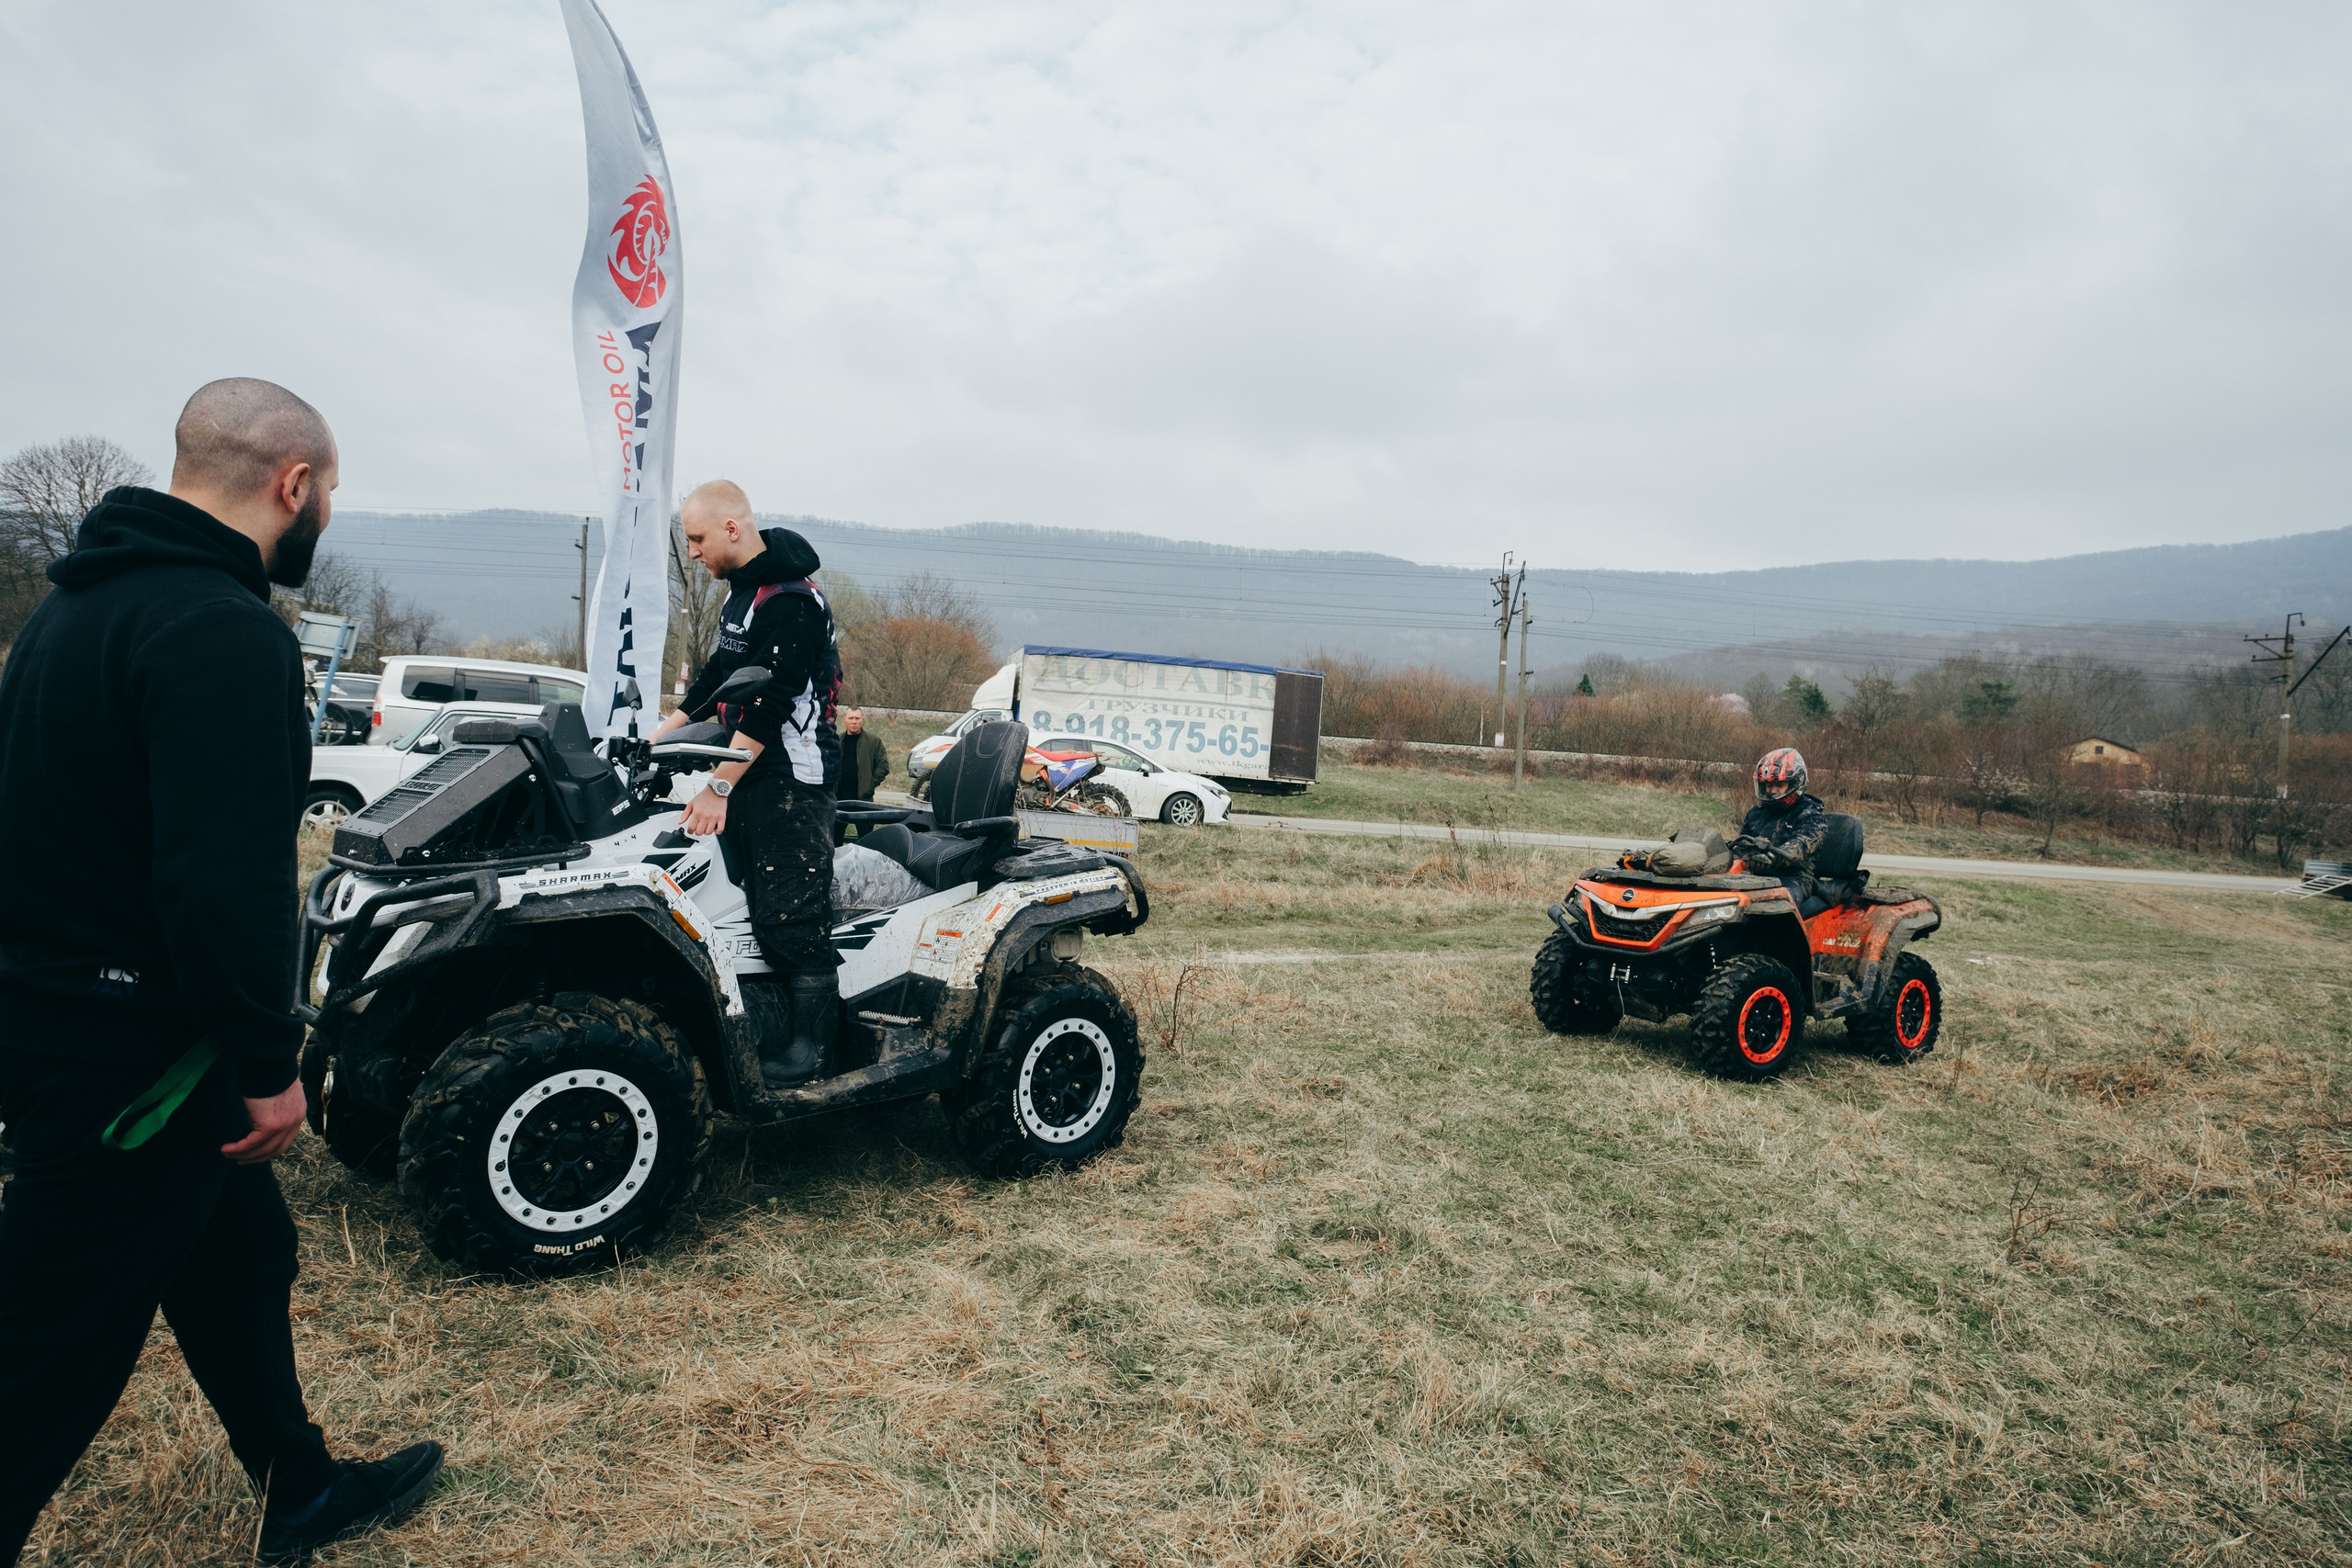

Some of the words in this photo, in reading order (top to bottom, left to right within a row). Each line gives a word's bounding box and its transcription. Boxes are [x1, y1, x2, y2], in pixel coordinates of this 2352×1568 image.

[597, 331, 625, 374] OIL
[609, 382, 633, 491] MOTOR
[1087, 698, 1250, 722] ГРУЗЧИКИ
[611, 799, 631, 817] EPS
[538, 872, 611, 886] SHARMAX
[1036, 882, 1069, 893] FREEDOM
[1079, 875, 1105, 886] MOTION
[575, 1235, 605, 1251] WILD
